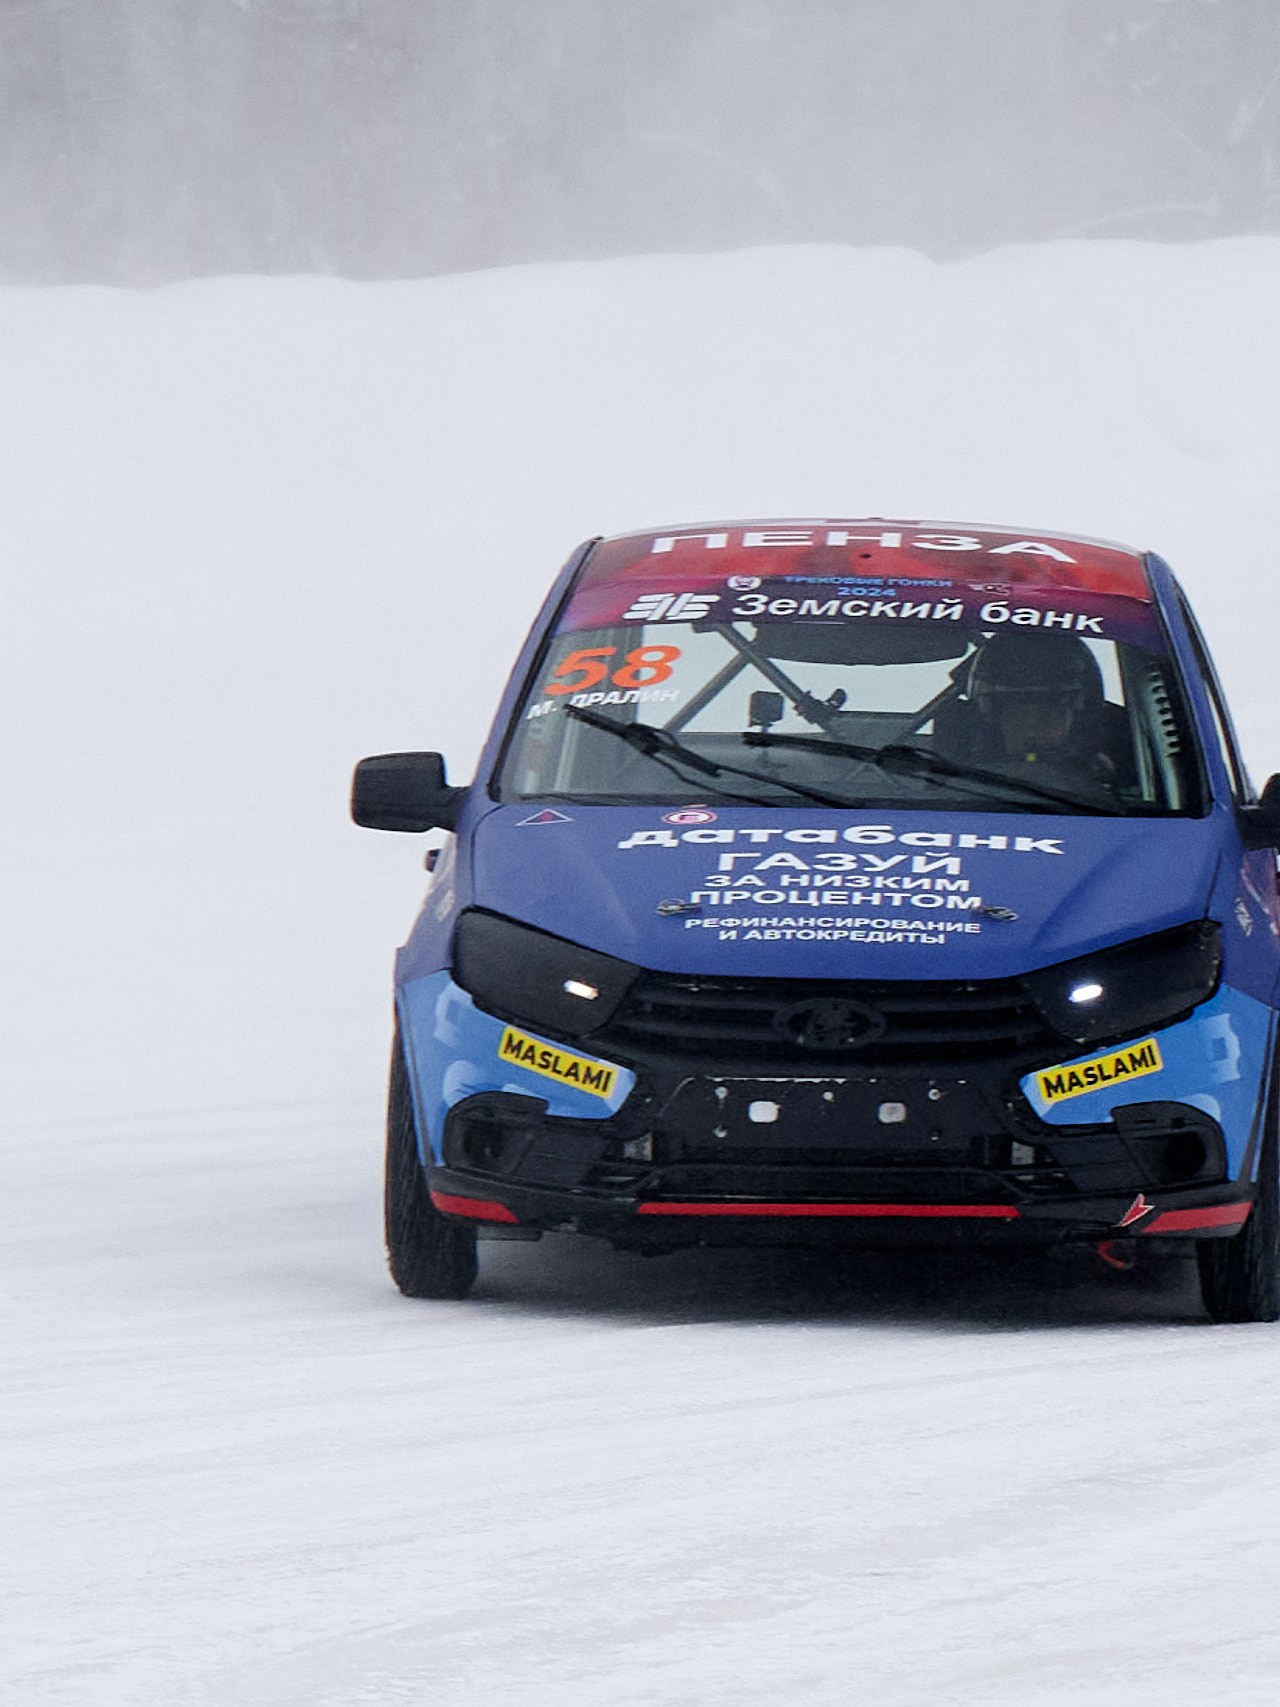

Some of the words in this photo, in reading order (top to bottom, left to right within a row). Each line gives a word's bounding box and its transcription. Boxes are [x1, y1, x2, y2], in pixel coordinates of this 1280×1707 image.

[651, 530, 1078, 564] ПЕНЗА
[838, 586, 897, 597] 2024
[731, 594, 965, 622] Земский
[980, 600, 1104, 634] банк
[544, 644, 682, 696] 58
[568, 689, 682, 709] ДРАЛИН
[618, 825, 1066, 855] датабанк
[718, 851, 963, 876] ГАЗУЙ
[704, 874, 766, 888] ЗА
[780, 874, 971, 893] НИЗКИМ
[690, 890, 983, 911] ПРОЦЕНТОМ
[685, 917, 982, 935] РЕФИНАНСИРОВАНИЕ
[718, 929, 738, 942] И
[743, 929, 946, 945] АВТОКРЕДИТЫ
[502, 1032, 614, 1093] MASLAMI
[1040, 1046, 1157, 1099] MASLAMI
